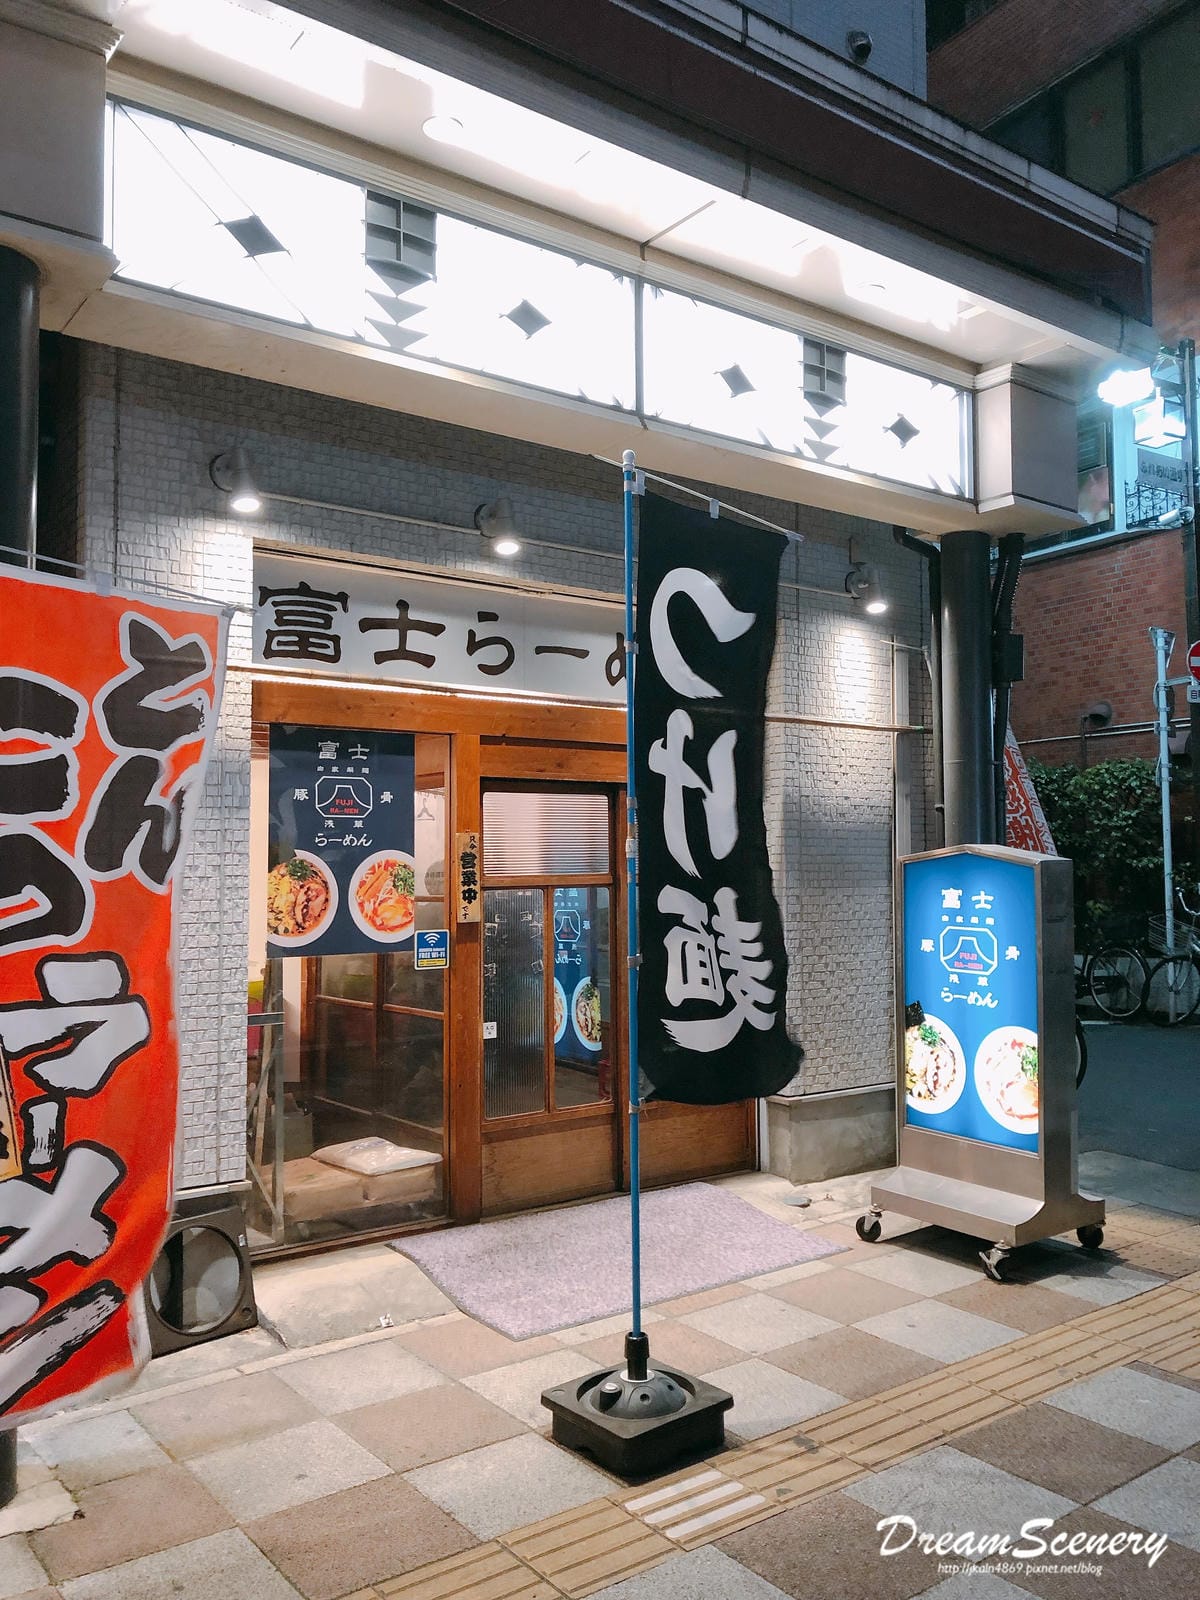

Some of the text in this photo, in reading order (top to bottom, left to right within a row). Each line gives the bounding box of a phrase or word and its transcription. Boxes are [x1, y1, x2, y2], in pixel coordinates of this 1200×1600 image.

[318, 741, 370, 760] 富士
[315, 833, 373, 847] らーめん
[941, 887, 994, 909] 富士
[940, 987, 998, 1008] らーめん
